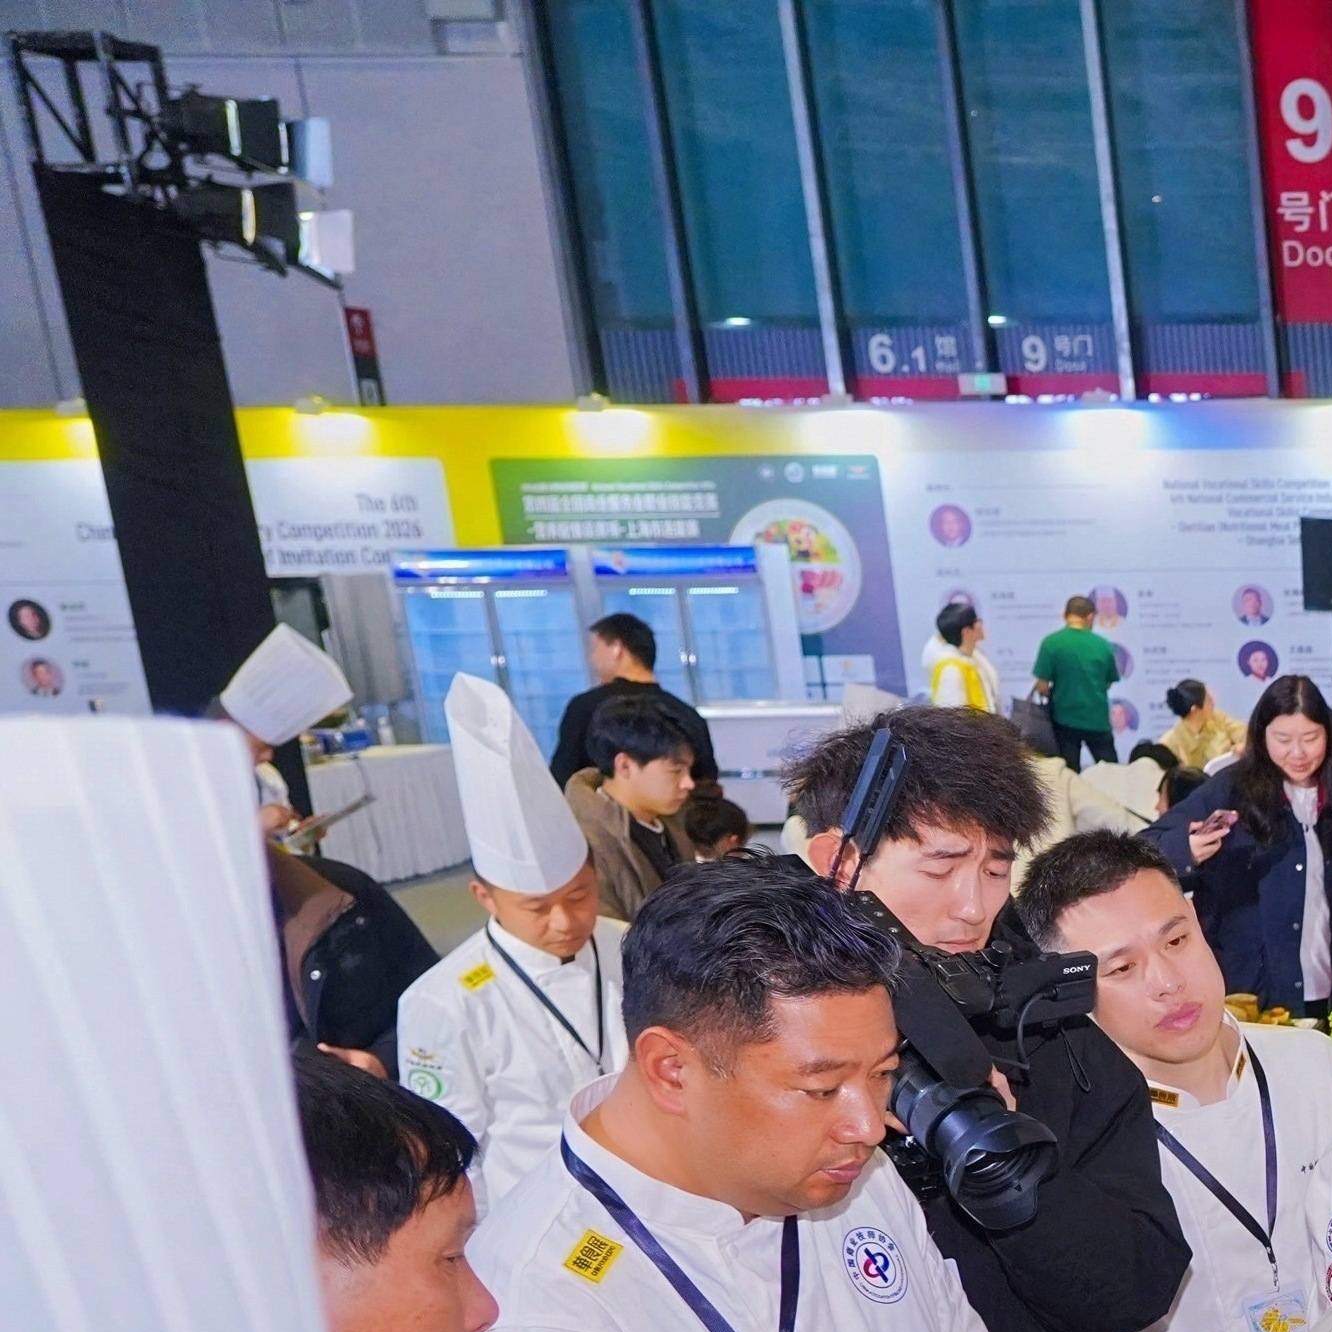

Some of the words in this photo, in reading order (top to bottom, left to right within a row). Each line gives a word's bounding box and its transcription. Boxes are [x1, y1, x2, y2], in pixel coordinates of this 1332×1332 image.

[868, 333, 927, 373] 6.1
[935, 335, 957, 357] 馆
[1021, 335, 1047, 373] 9
[1054, 334, 1093, 358] 号门
[355, 493, 386, 512] The
[276, 523, 379, 543] Competition
[384, 522, 422, 540] 2026
